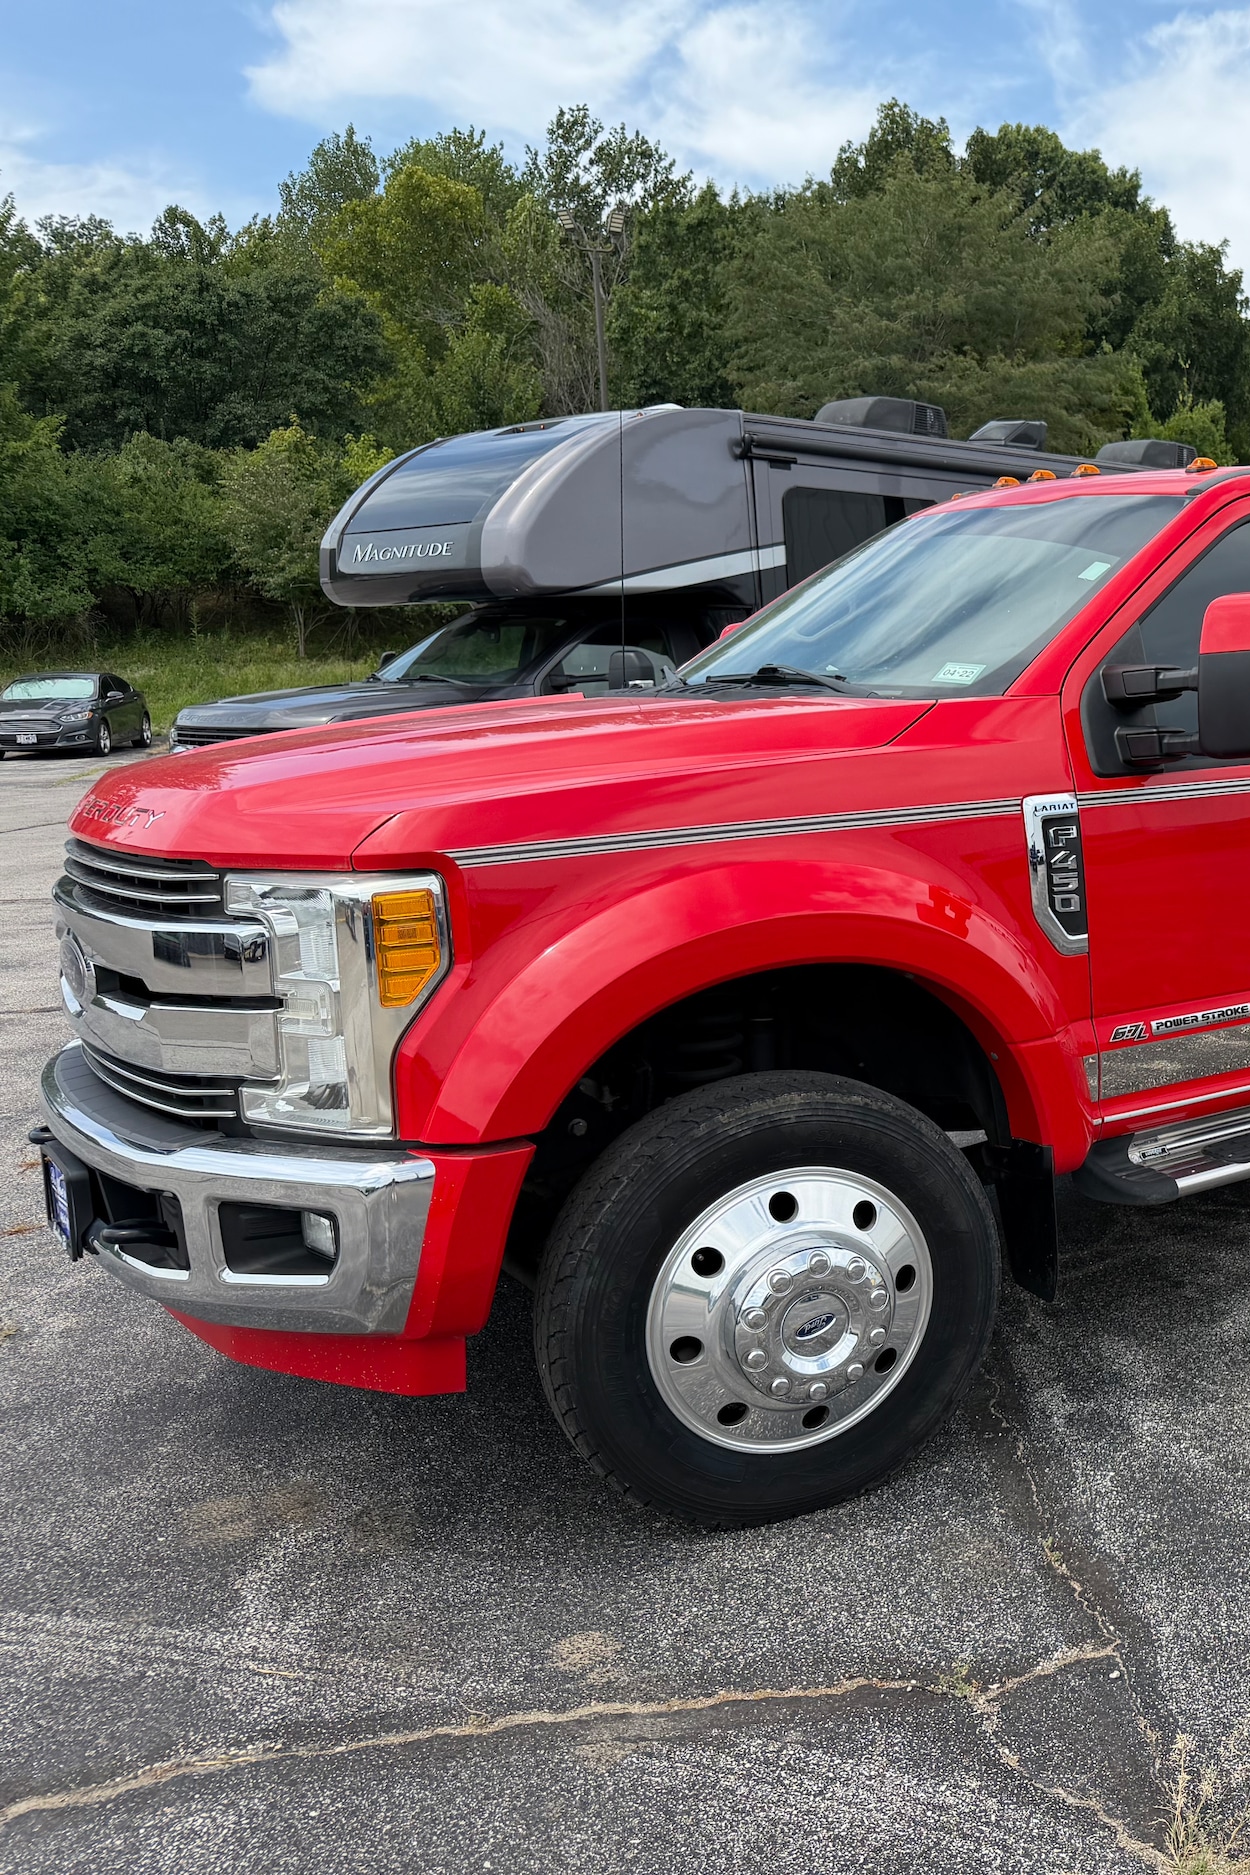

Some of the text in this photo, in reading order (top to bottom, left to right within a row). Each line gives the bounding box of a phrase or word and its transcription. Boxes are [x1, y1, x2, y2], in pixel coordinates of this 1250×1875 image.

[352, 542, 454, 563] MAGNITUDE
[1034, 802, 1076, 813] LARIAT
[1156, 1015, 1199, 1031] POWER
[1201, 1004, 1250, 1021] STROKE
[804, 1315, 828, 1334] Ford
